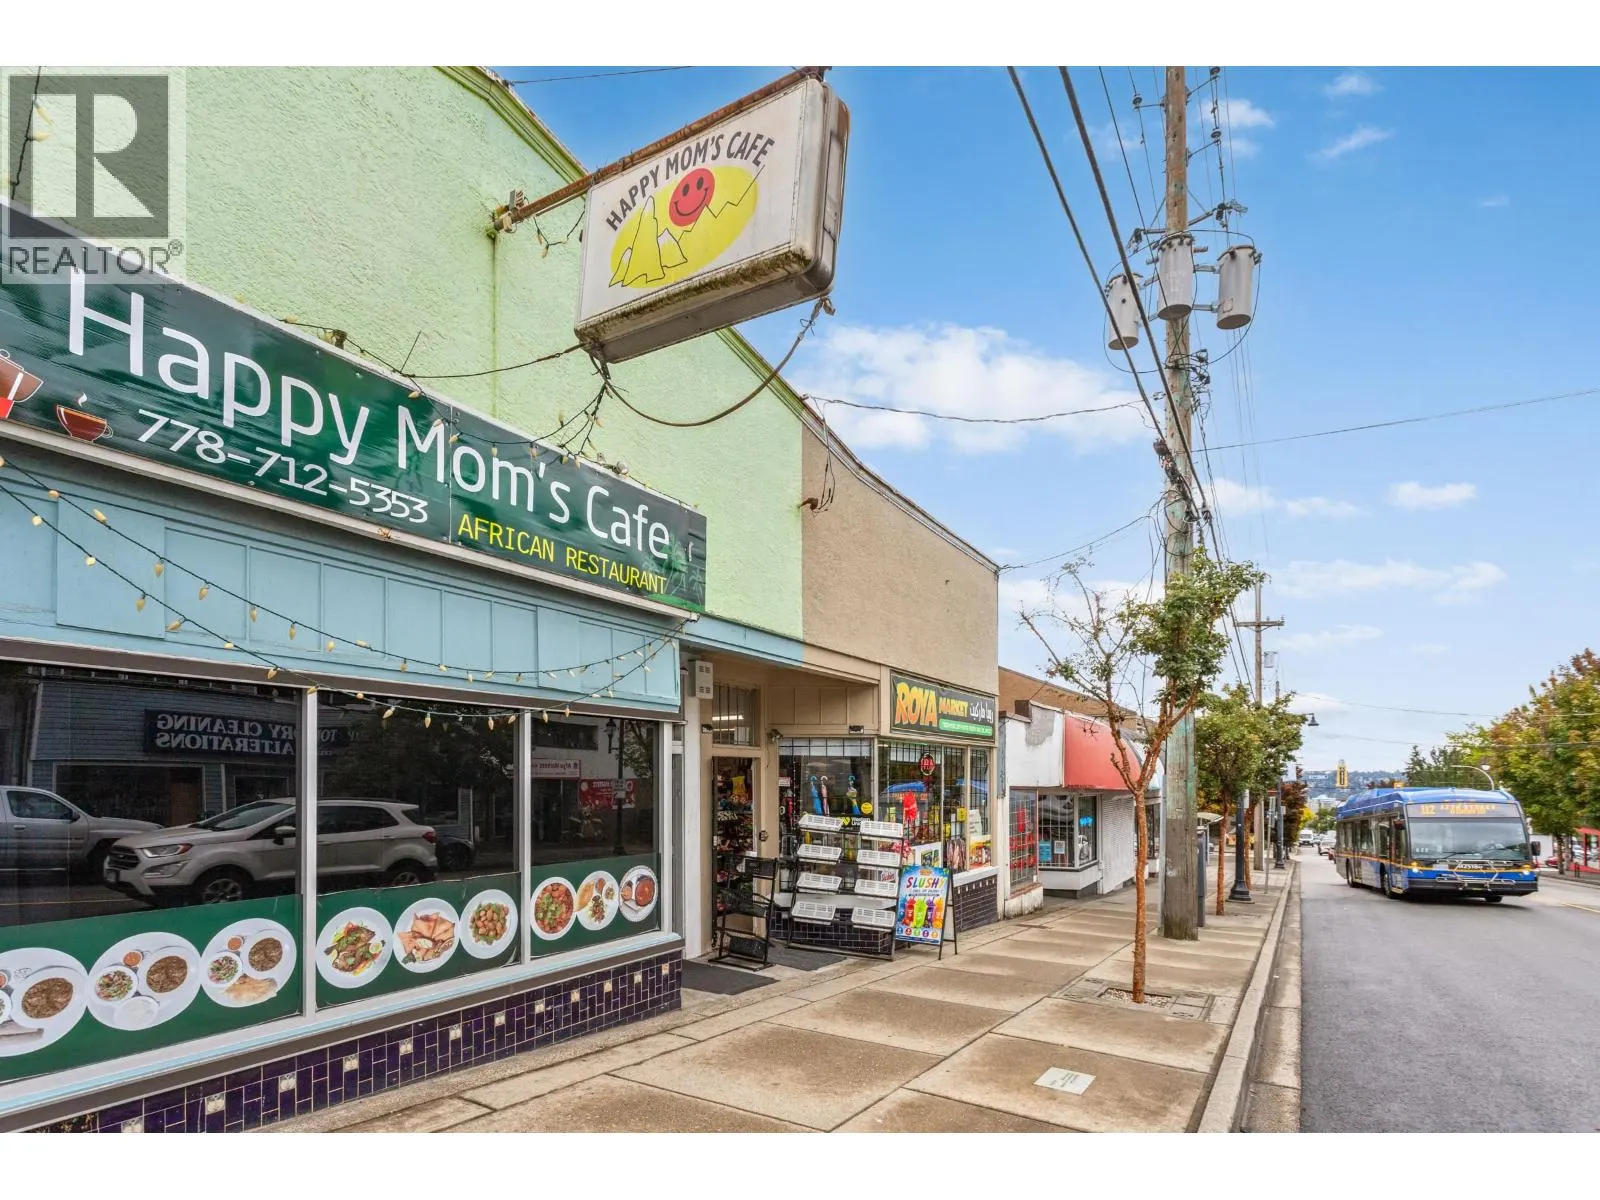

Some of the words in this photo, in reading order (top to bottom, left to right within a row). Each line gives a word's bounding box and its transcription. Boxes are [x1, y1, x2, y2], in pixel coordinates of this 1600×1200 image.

[606, 165, 659, 231] HAPPY
[665, 134, 724, 180] MOM'S
[727, 131, 775, 167] CAFE
[69, 268, 370, 465] Happy
[398, 405, 571, 523] Mom's
[587, 485, 670, 560] Cafe
[137, 409, 428, 523] 778-712-5353
[457, 514, 555, 562] AFRICAN
[566, 548, 667, 594] RESTAURANT
[895, 682, 938, 727] ROYA
[939, 697, 968, 717] MARKET
[906, 876, 945, 889] SLUSHY
